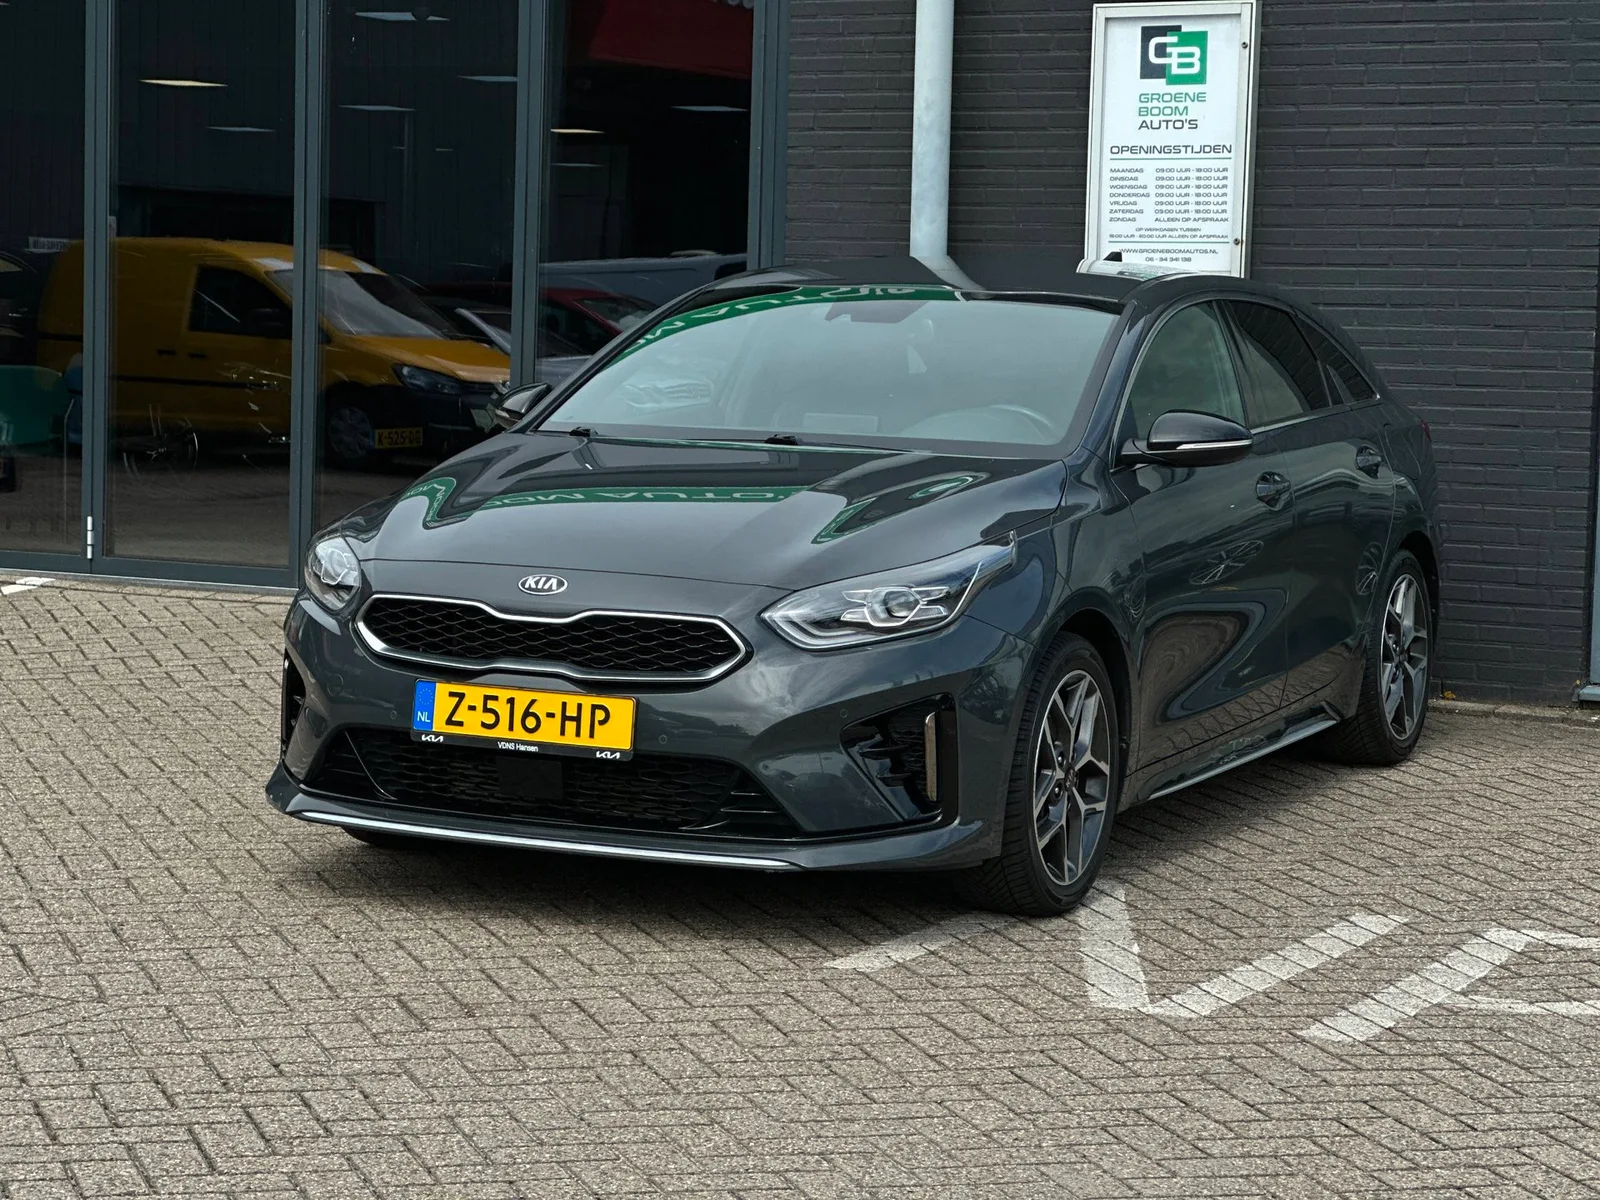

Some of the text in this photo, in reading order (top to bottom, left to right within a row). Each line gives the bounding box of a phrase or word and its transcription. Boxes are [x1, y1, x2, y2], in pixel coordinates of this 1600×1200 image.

[1138, 92, 1207, 103] GROENE
[1137, 105, 1189, 117] BOOM
[1137, 118, 1199, 130] AUTO'S
[1109, 144, 1233, 155] OPENINGSTIJDEN
[524, 576, 558, 591] KIA
[416, 711, 431, 723] NL
[445, 690, 612, 739] Z-516-HP
[497, 741, 539, 752] VDNS Hansen
